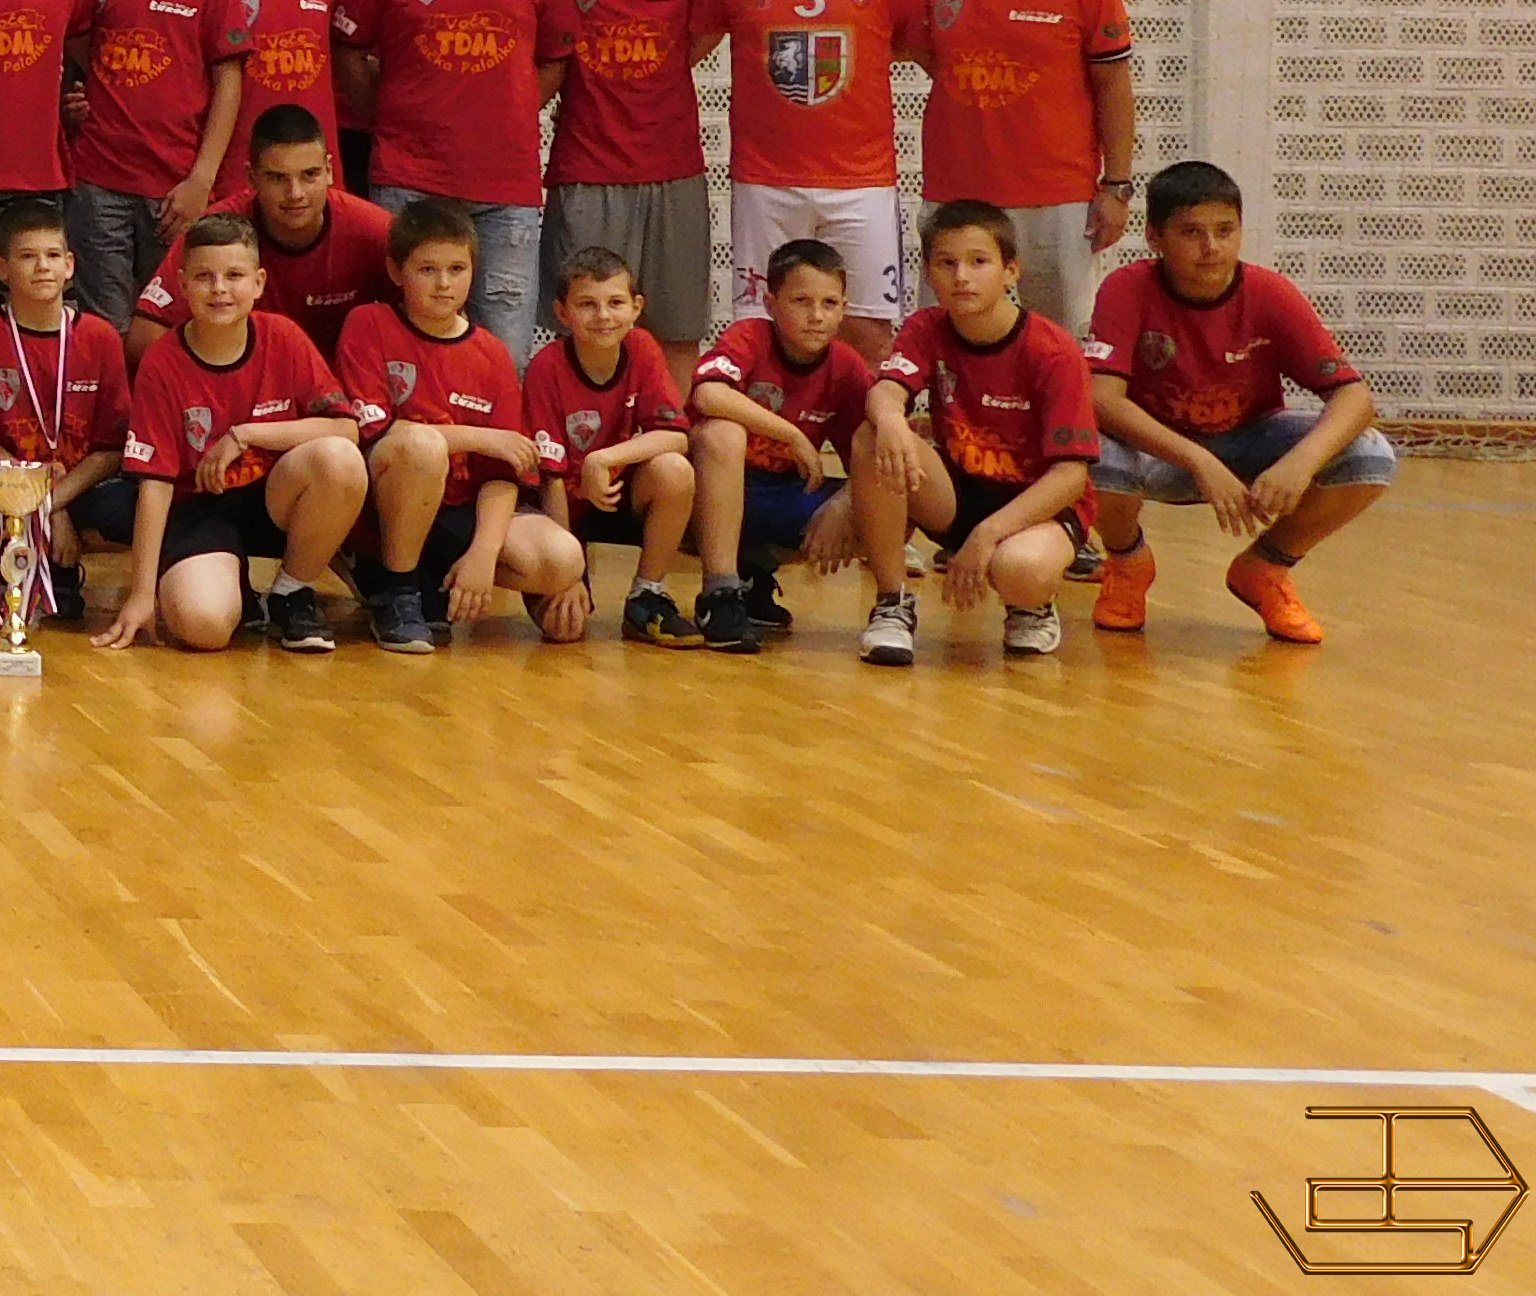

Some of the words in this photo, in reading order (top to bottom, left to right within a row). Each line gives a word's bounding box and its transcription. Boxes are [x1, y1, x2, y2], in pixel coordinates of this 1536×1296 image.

[436, 32, 497, 56] TDM
[598, 38, 658, 63] TDM
[260, 50, 314, 75] TDM
[882, 265, 899, 303] 3
